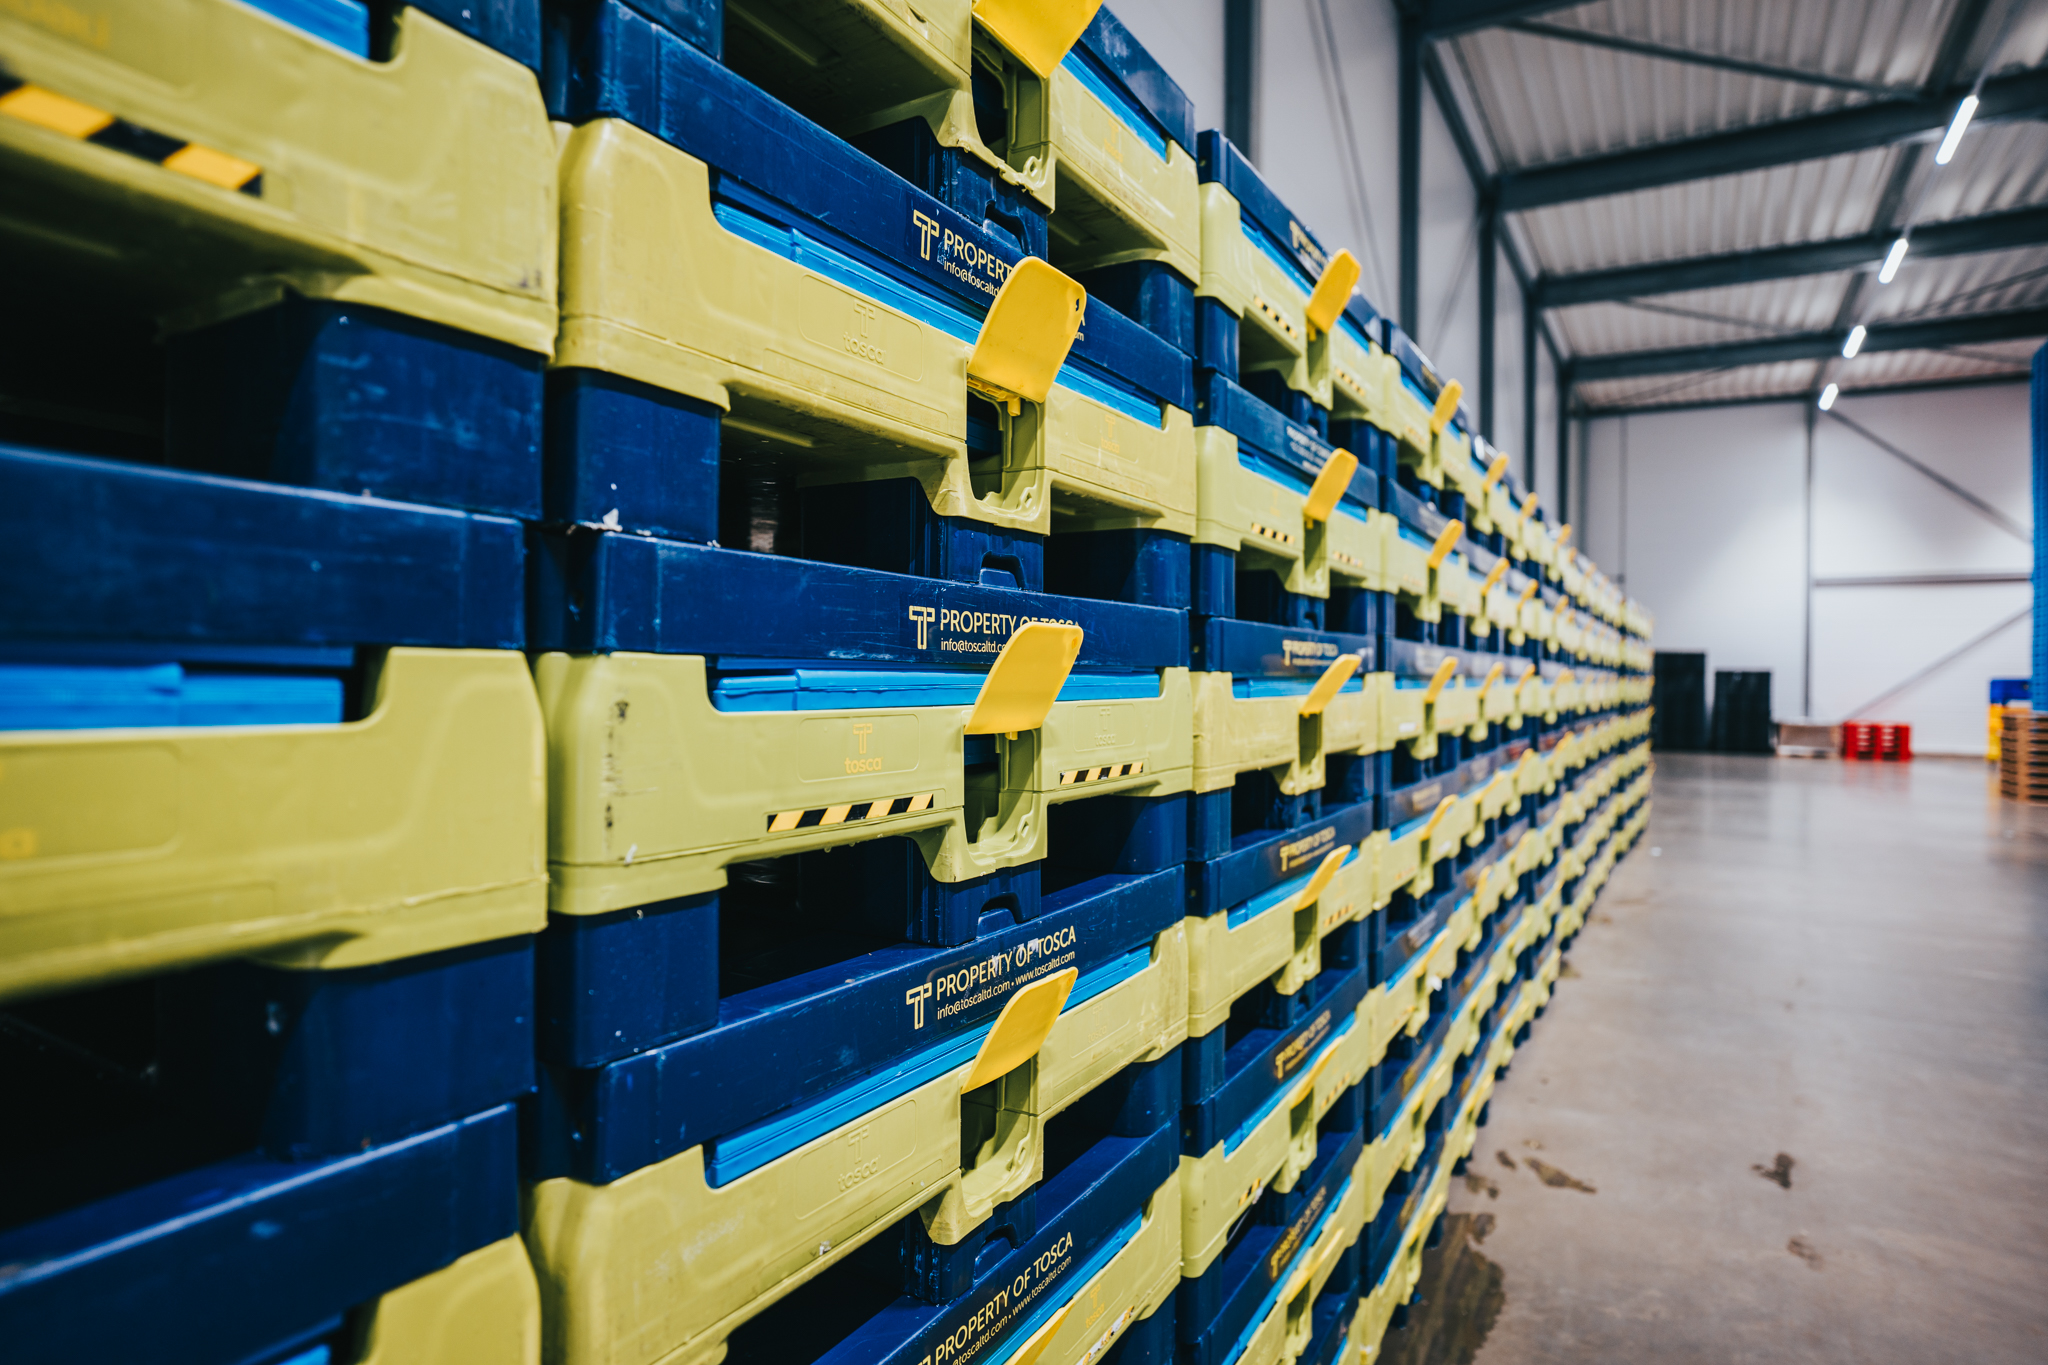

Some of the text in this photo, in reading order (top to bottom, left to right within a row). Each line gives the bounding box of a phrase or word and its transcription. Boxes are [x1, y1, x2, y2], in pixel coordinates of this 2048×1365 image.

[944, 228, 1015, 283] PROPERT
[843, 331, 885, 365] tosca
[940, 608, 1017, 635] PROPERTY
[844, 756, 882, 774] tosca
[936, 925, 1077, 1001] PROPERTY OF TOSCA
[937, 950, 1076, 1020] info@toscaltd.com www.toscaltd.com
[838, 1155, 878, 1193] tosca
[935, 1231, 1073, 1365] PROPERTY OF TOSCA
[1012, 1255, 1072, 1317] www.toscaltd.com
